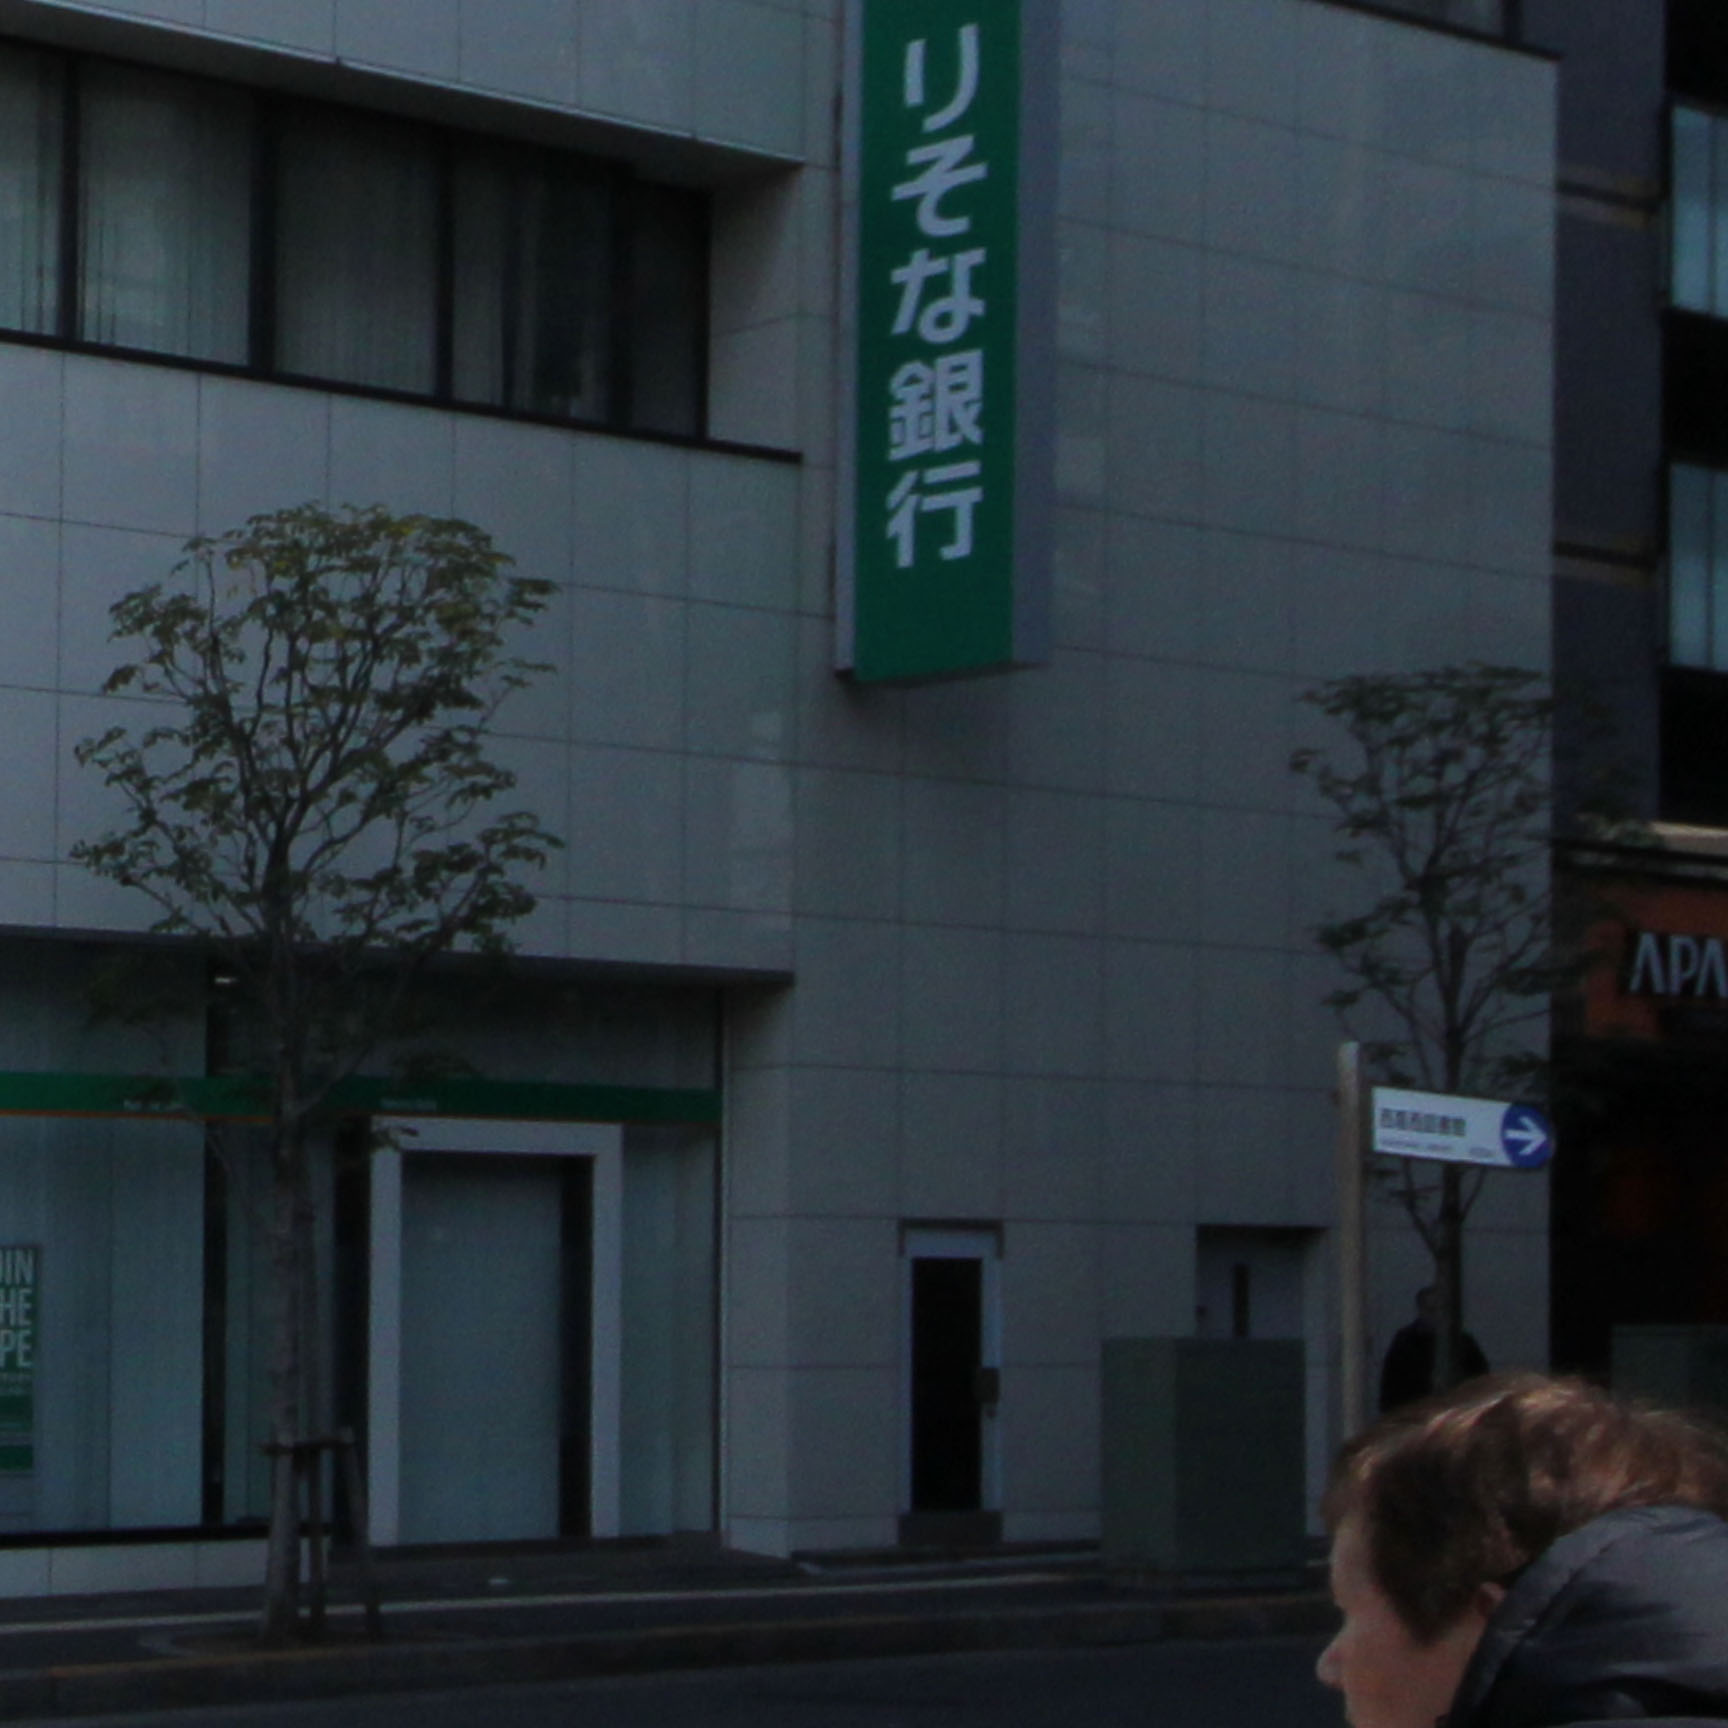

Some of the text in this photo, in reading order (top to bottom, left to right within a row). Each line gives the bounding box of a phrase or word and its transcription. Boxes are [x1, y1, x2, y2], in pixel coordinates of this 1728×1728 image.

[886, 24, 989, 569] りそな銀行
[1629, 931, 1728, 998] APA
